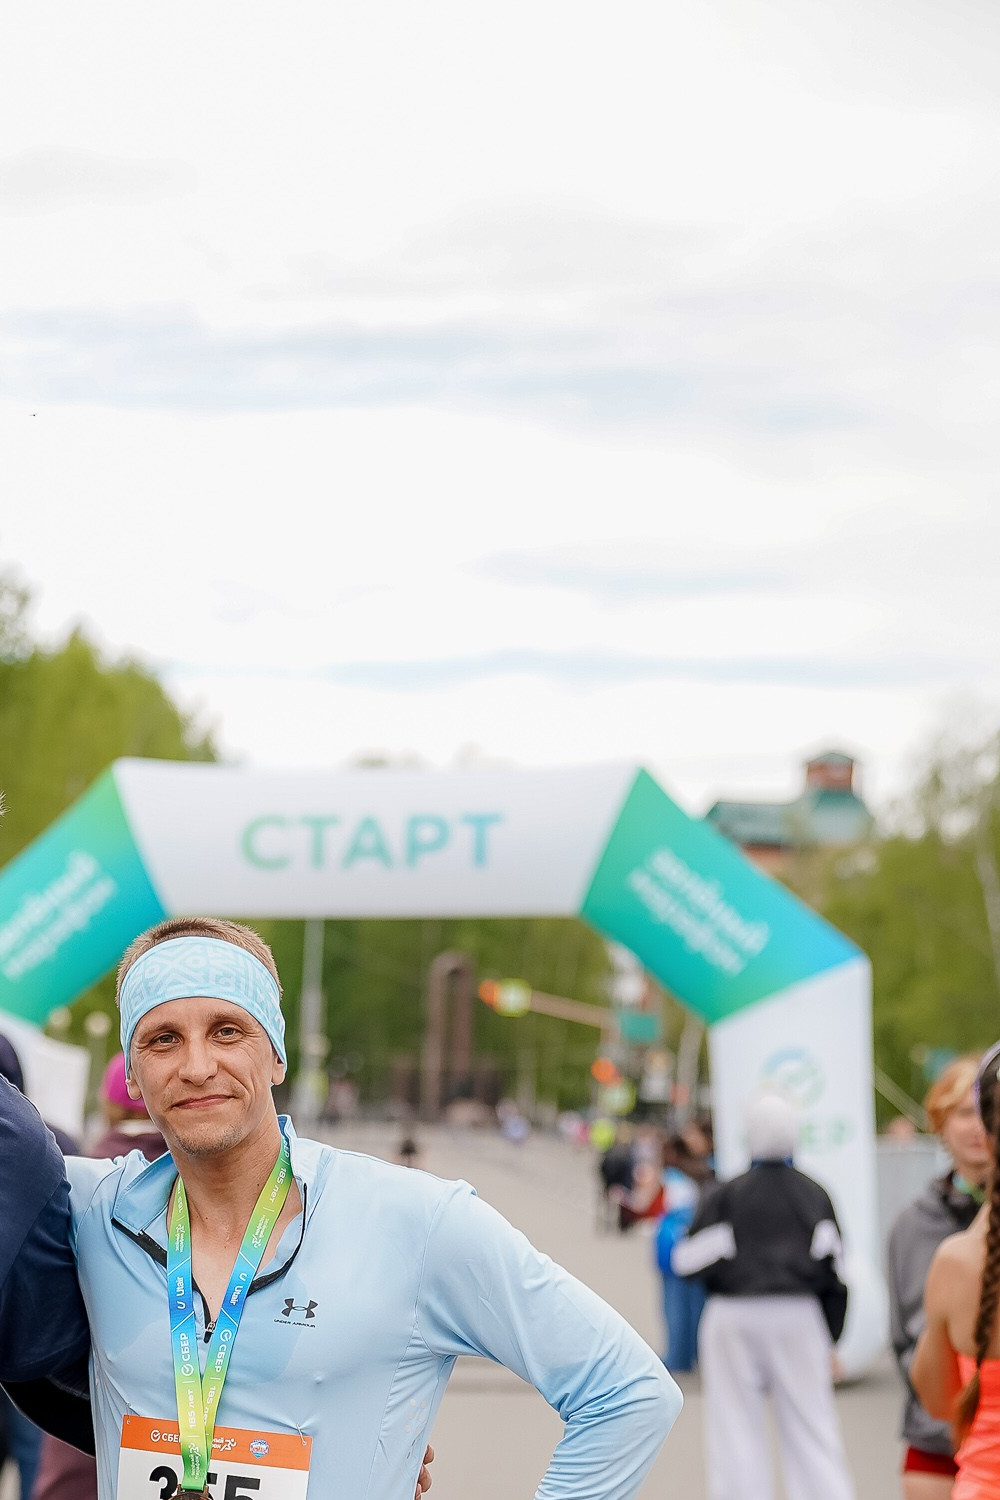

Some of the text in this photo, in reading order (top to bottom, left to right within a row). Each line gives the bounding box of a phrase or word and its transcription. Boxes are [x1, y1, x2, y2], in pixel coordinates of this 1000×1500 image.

[240, 813, 506, 871] СТАРТ
[277, 1167, 287, 1185] 185
[176, 1276, 185, 1297] Utair
[230, 1285, 244, 1306] Utair
[180, 1332, 191, 1362] СБЕР
[214, 1344, 227, 1373] СБЕР
[206, 1385, 216, 1404] 185
[161, 1433, 181, 1443] СБЕ
